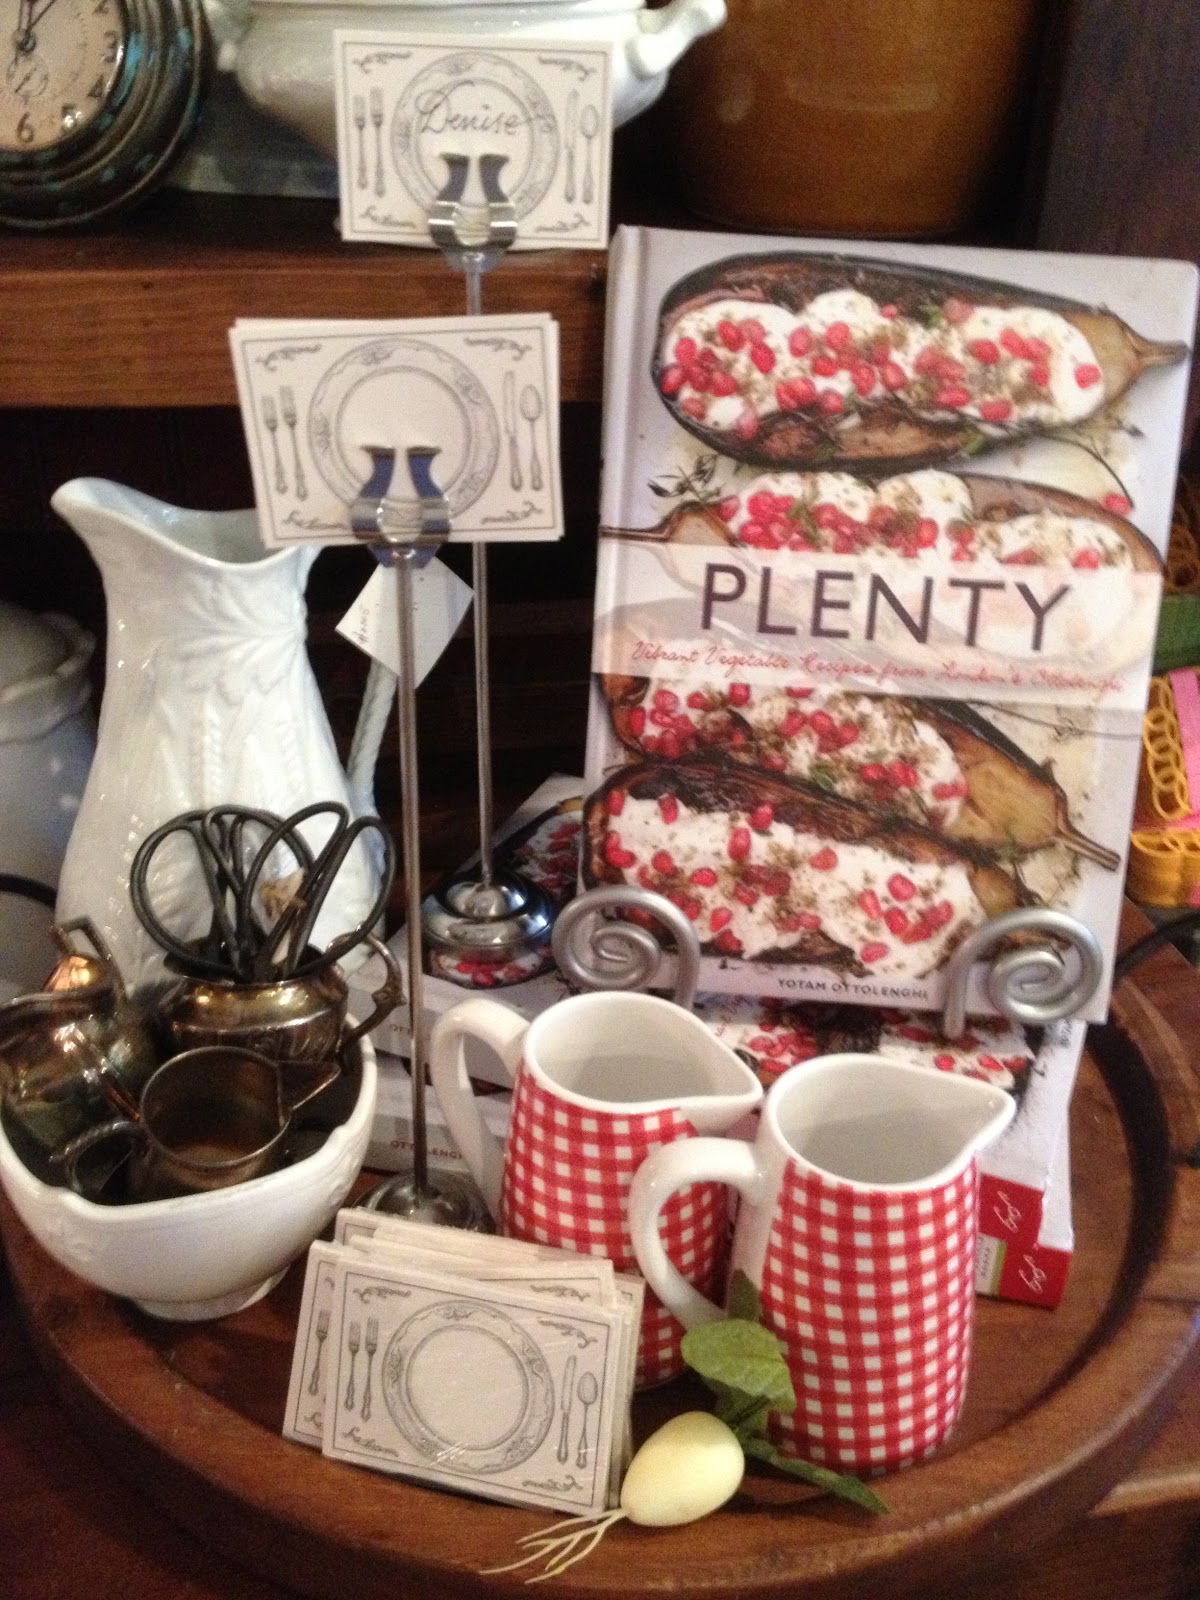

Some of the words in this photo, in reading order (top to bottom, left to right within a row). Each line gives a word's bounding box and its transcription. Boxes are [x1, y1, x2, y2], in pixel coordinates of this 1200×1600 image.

[414, 79, 550, 135] Denise
[16, 112, 35, 144] 6
[701, 562, 1071, 652] PLENTY
[631, 640, 699, 664] Vibrant
[778, 977, 827, 992] YOTAM
[831, 981, 927, 1001] OTTOLENGHI
